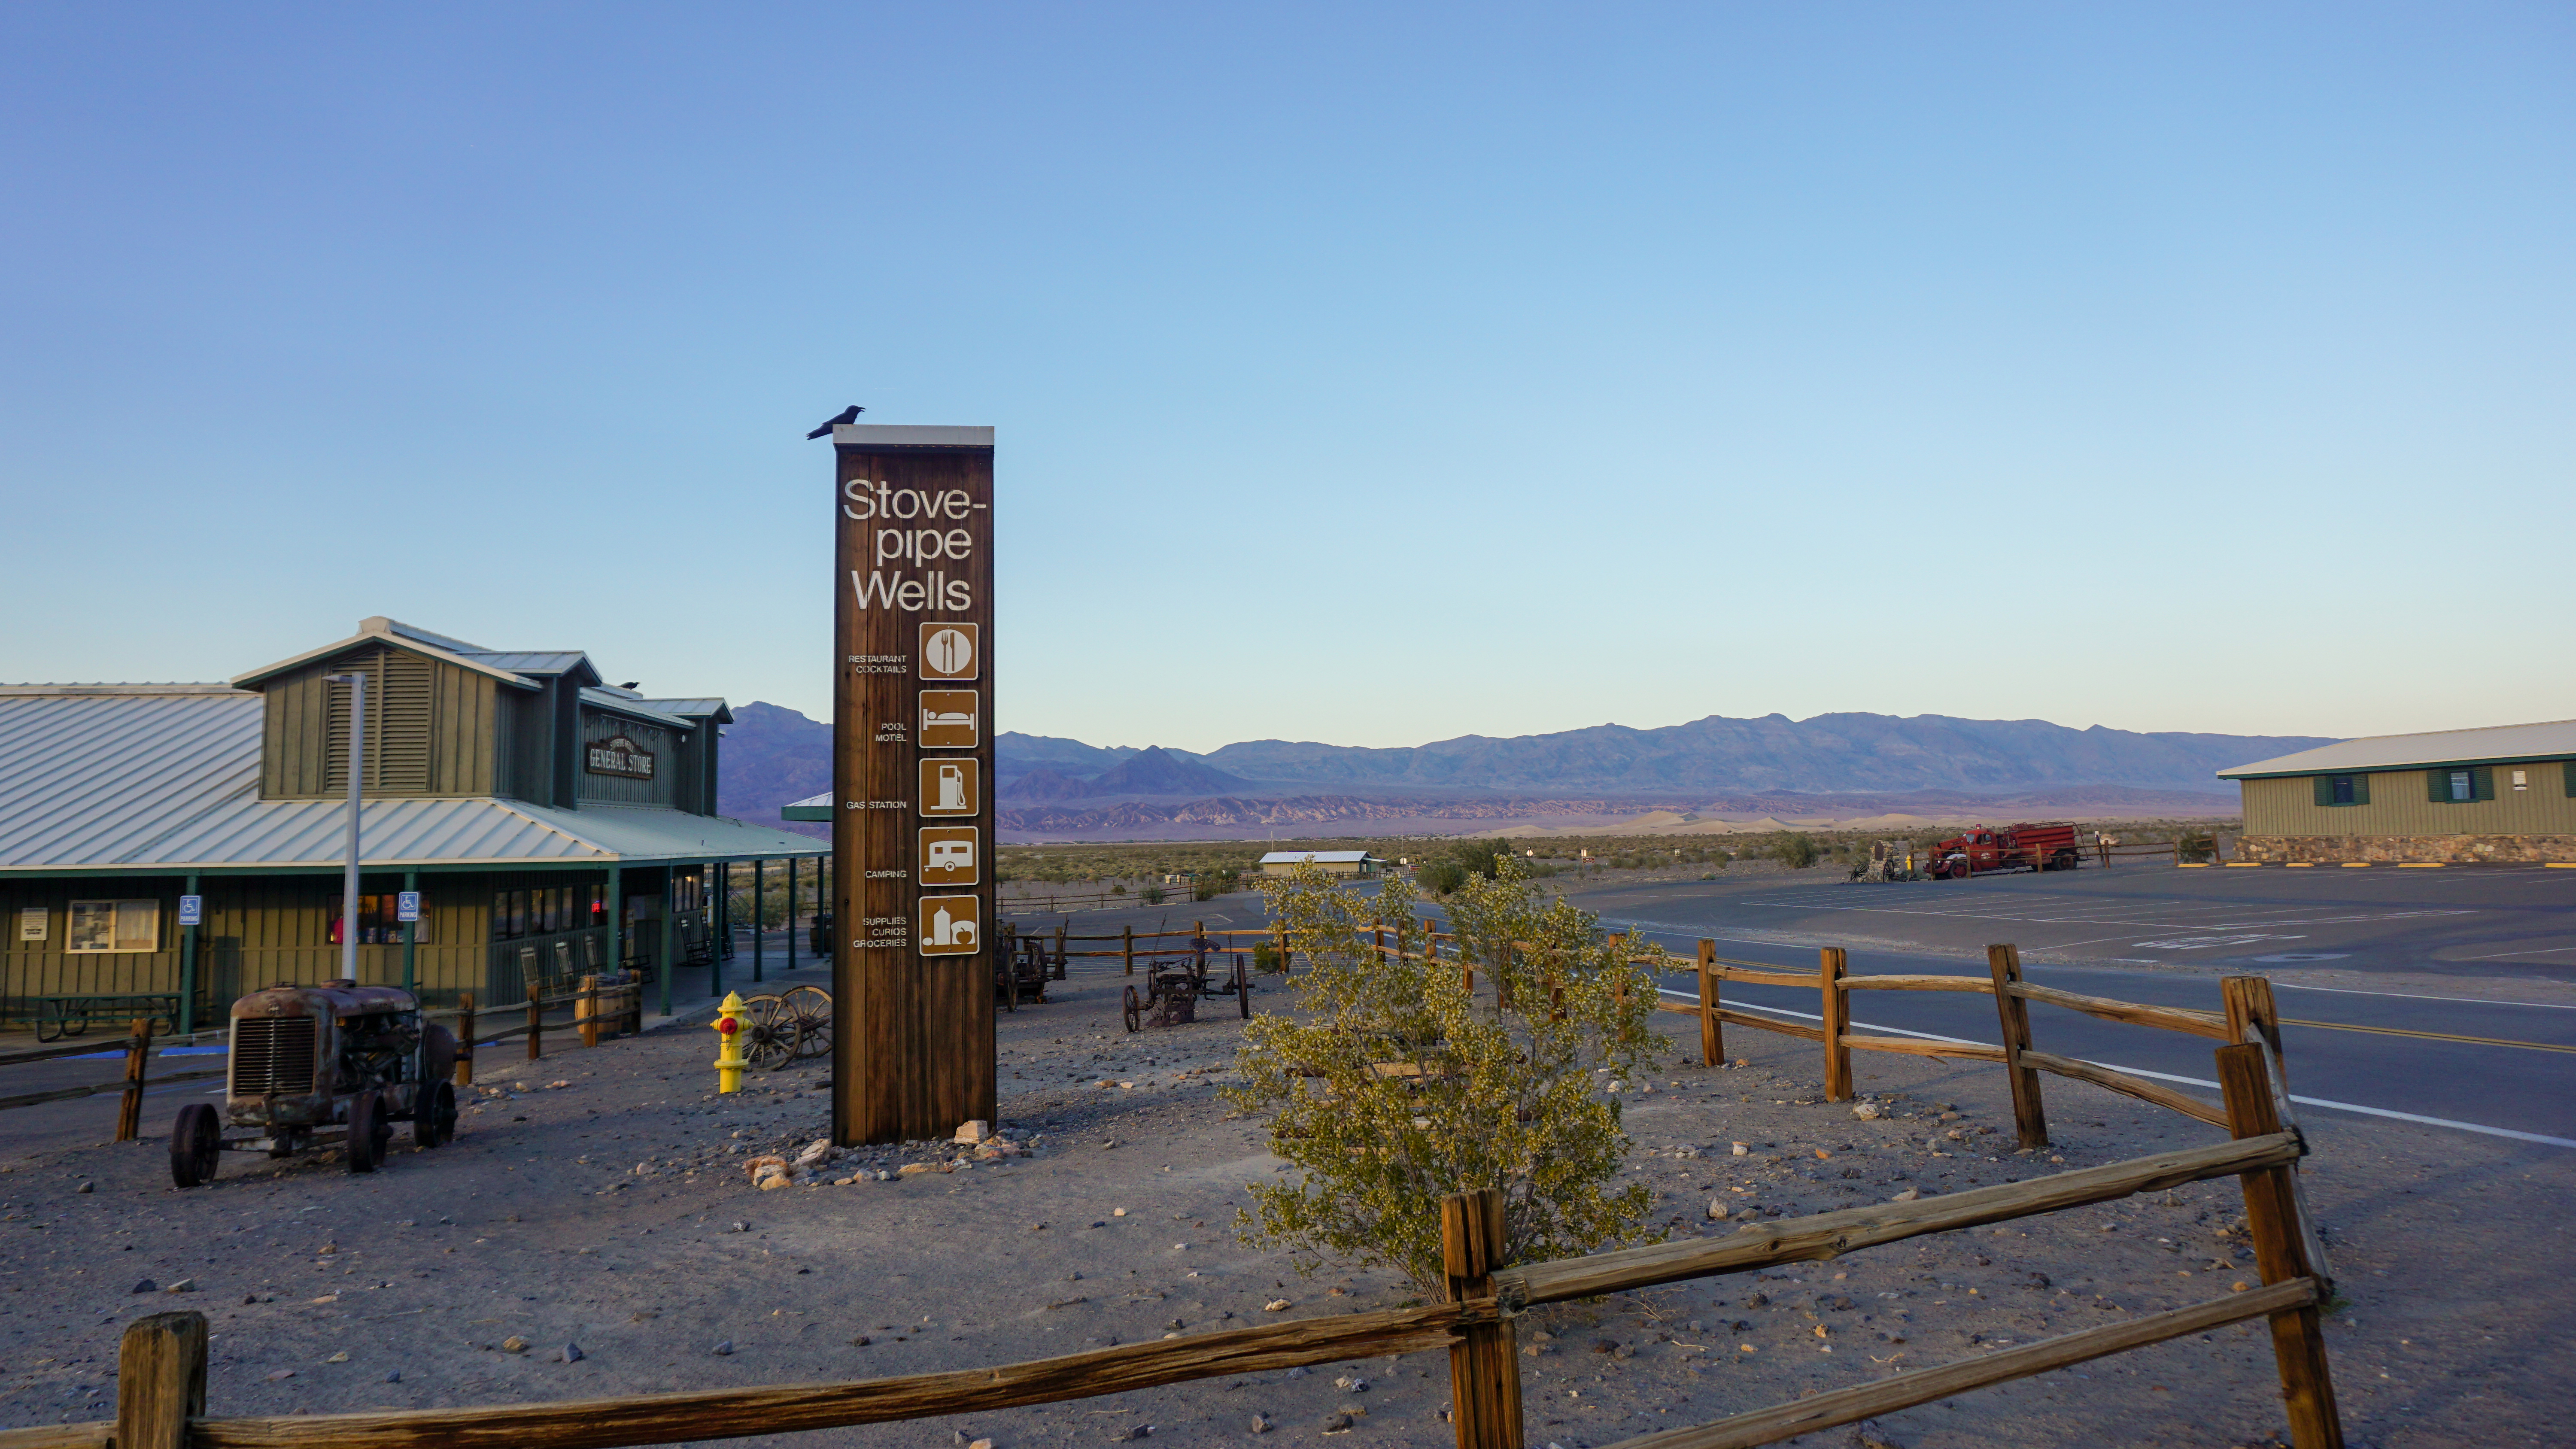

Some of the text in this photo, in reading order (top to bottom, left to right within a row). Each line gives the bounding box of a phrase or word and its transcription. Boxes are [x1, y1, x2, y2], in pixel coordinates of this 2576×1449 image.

[843, 479, 987, 519] Stove-
[877, 529, 972, 567] pipe
[851, 570, 971, 611] Wells
[848, 655, 907, 663] RESTAURANT
[590, 748, 651, 774] GENERAL STORE
[863, 917, 906, 925] SUPPLIES
[853, 939, 907, 948] GROCERIES
